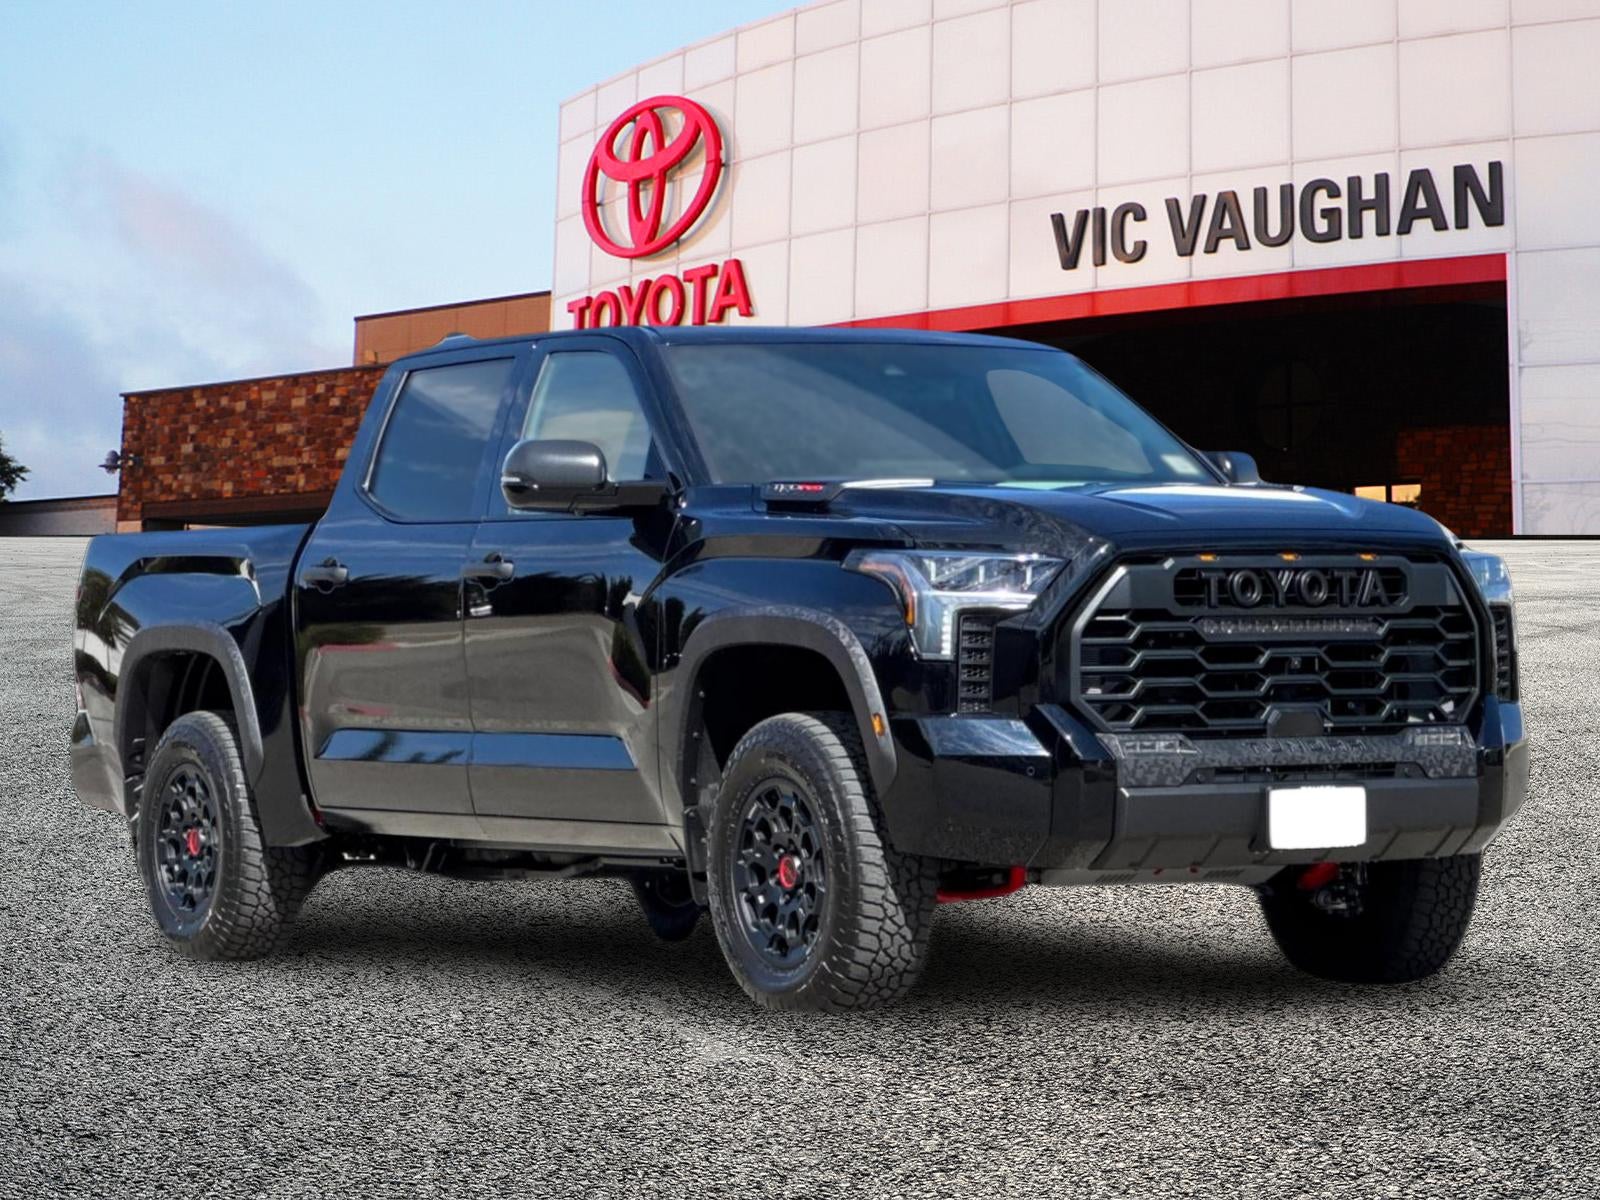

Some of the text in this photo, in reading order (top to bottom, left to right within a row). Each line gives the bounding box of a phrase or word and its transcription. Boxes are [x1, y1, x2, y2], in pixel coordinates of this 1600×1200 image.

[1050, 160, 1505, 271] VIC VAUGHAN
[567, 258, 754, 330] TOYOTA
[1200, 568, 1390, 608] TOYOTA
